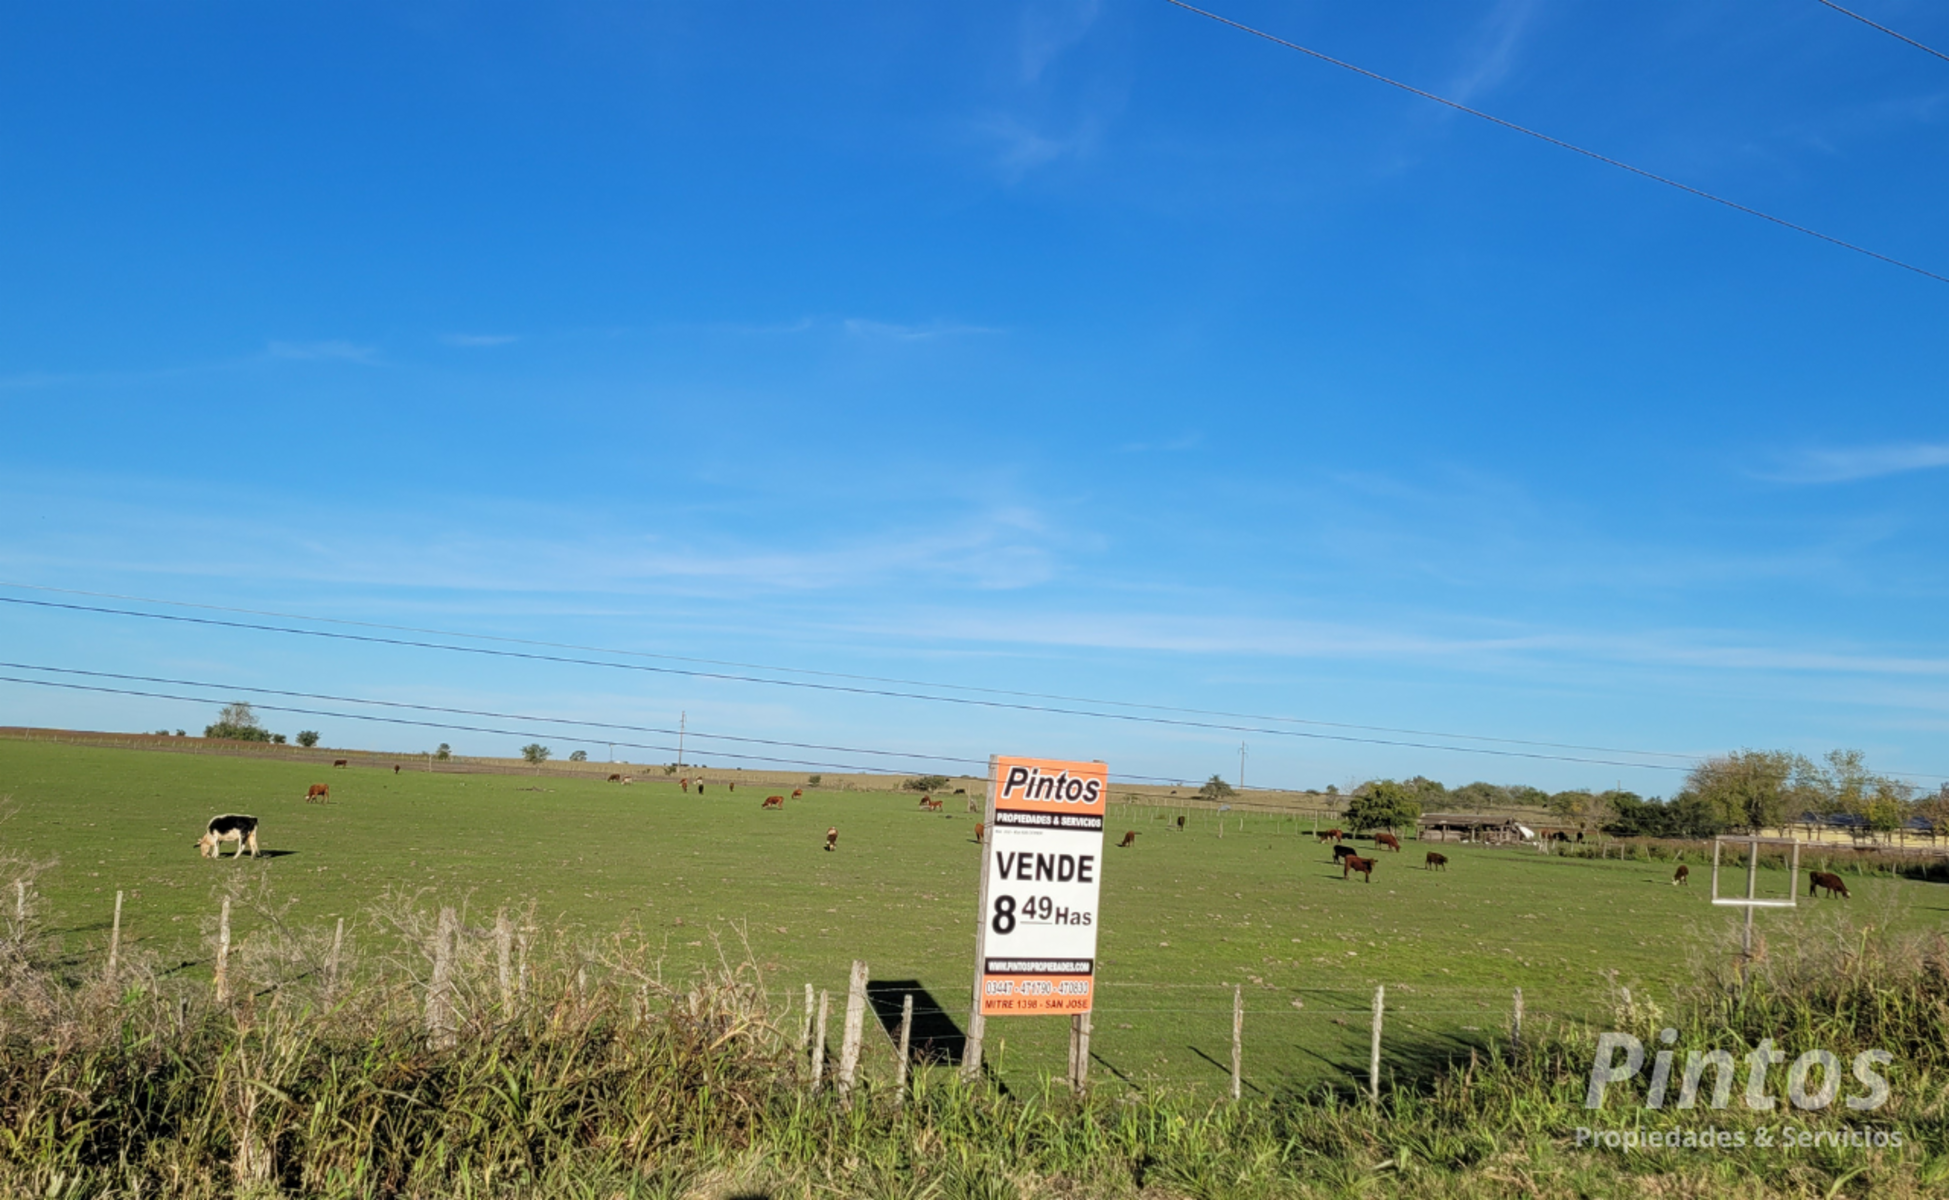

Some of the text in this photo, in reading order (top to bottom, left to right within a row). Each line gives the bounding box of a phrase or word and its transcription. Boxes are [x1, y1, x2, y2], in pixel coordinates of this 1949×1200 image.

[1002, 766, 1102, 805] Pintos
[996, 812, 1102, 828] PROPIEDADES & SERVICIOS
[996, 851, 1094, 883] VENDE
[992, 894, 1016, 935] 8
[1054, 906, 1092, 926] Has
[985, 999, 1014, 1009] MITRE
[1045, 999, 1064, 1009] SAN
